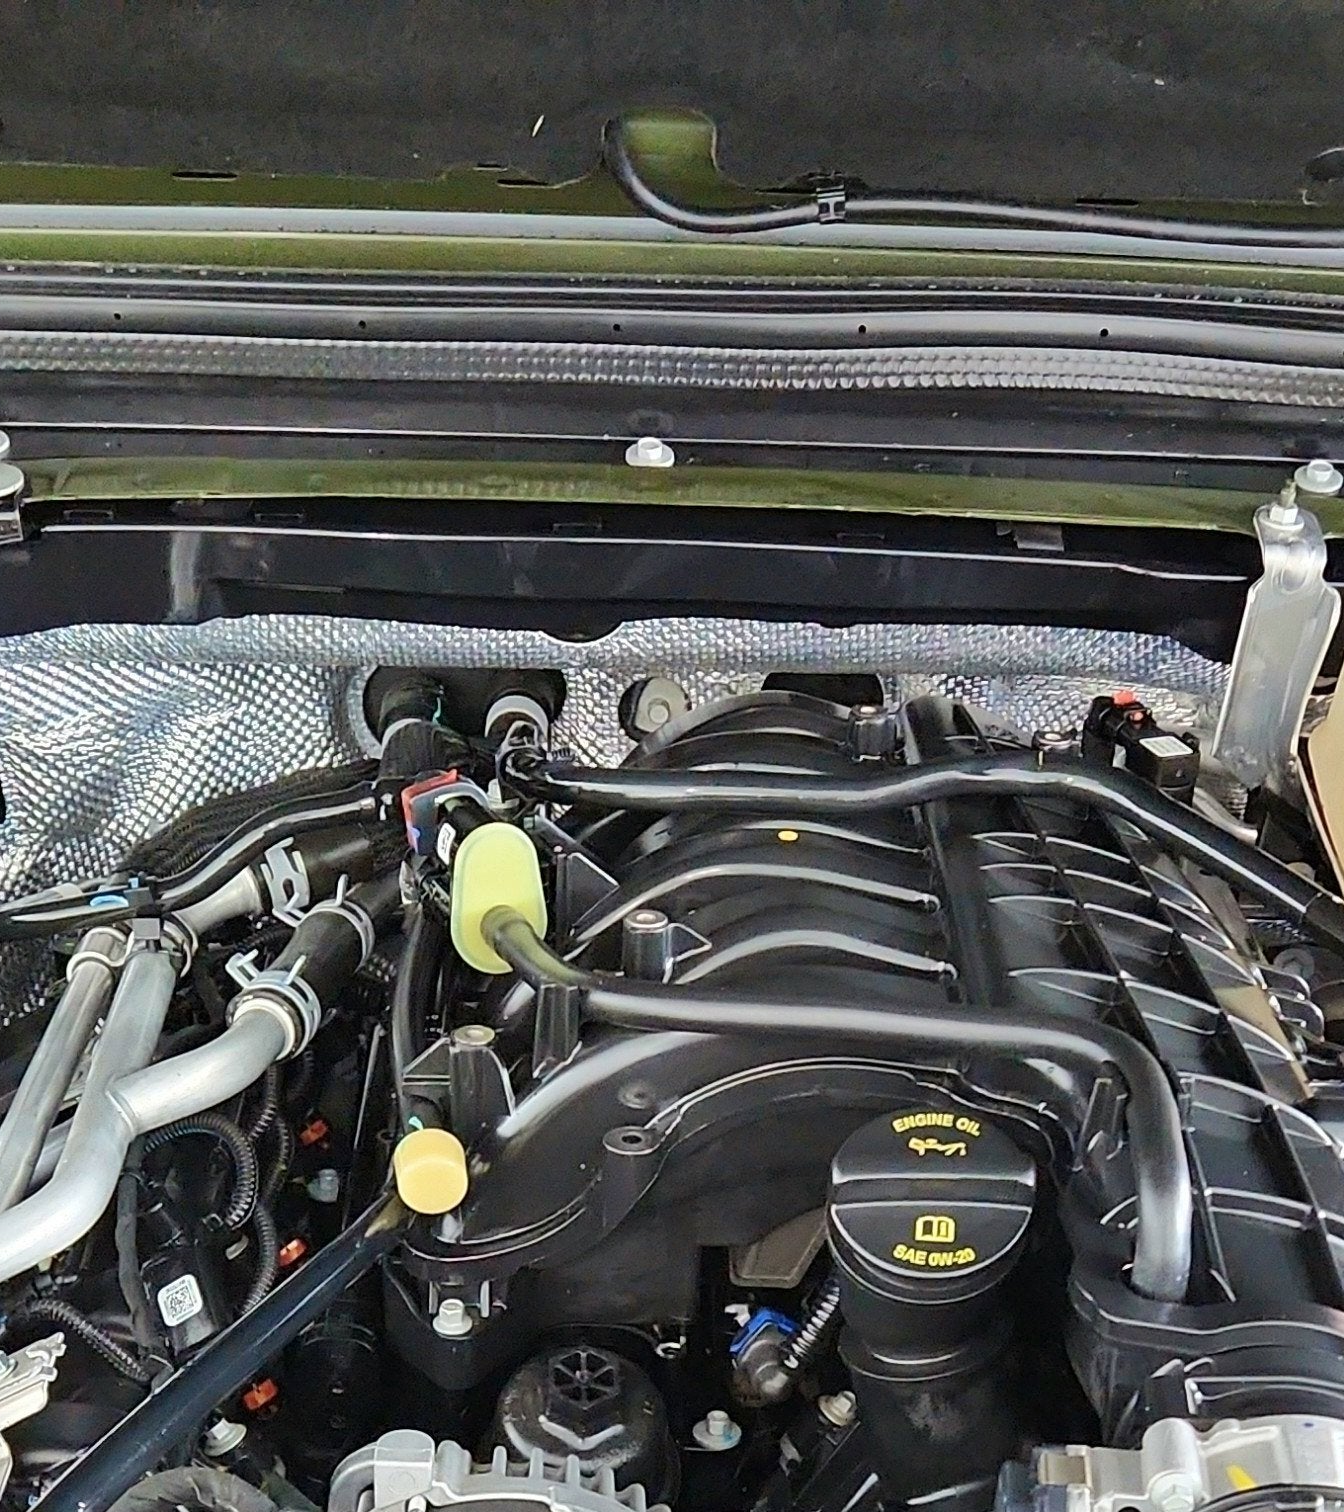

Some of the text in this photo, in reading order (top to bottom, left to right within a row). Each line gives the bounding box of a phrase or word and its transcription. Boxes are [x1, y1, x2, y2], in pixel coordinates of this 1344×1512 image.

[892, 1113, 982, 1136] ENGINE OIL
[893, 1244, 976, 1266] SAE 0W-20
